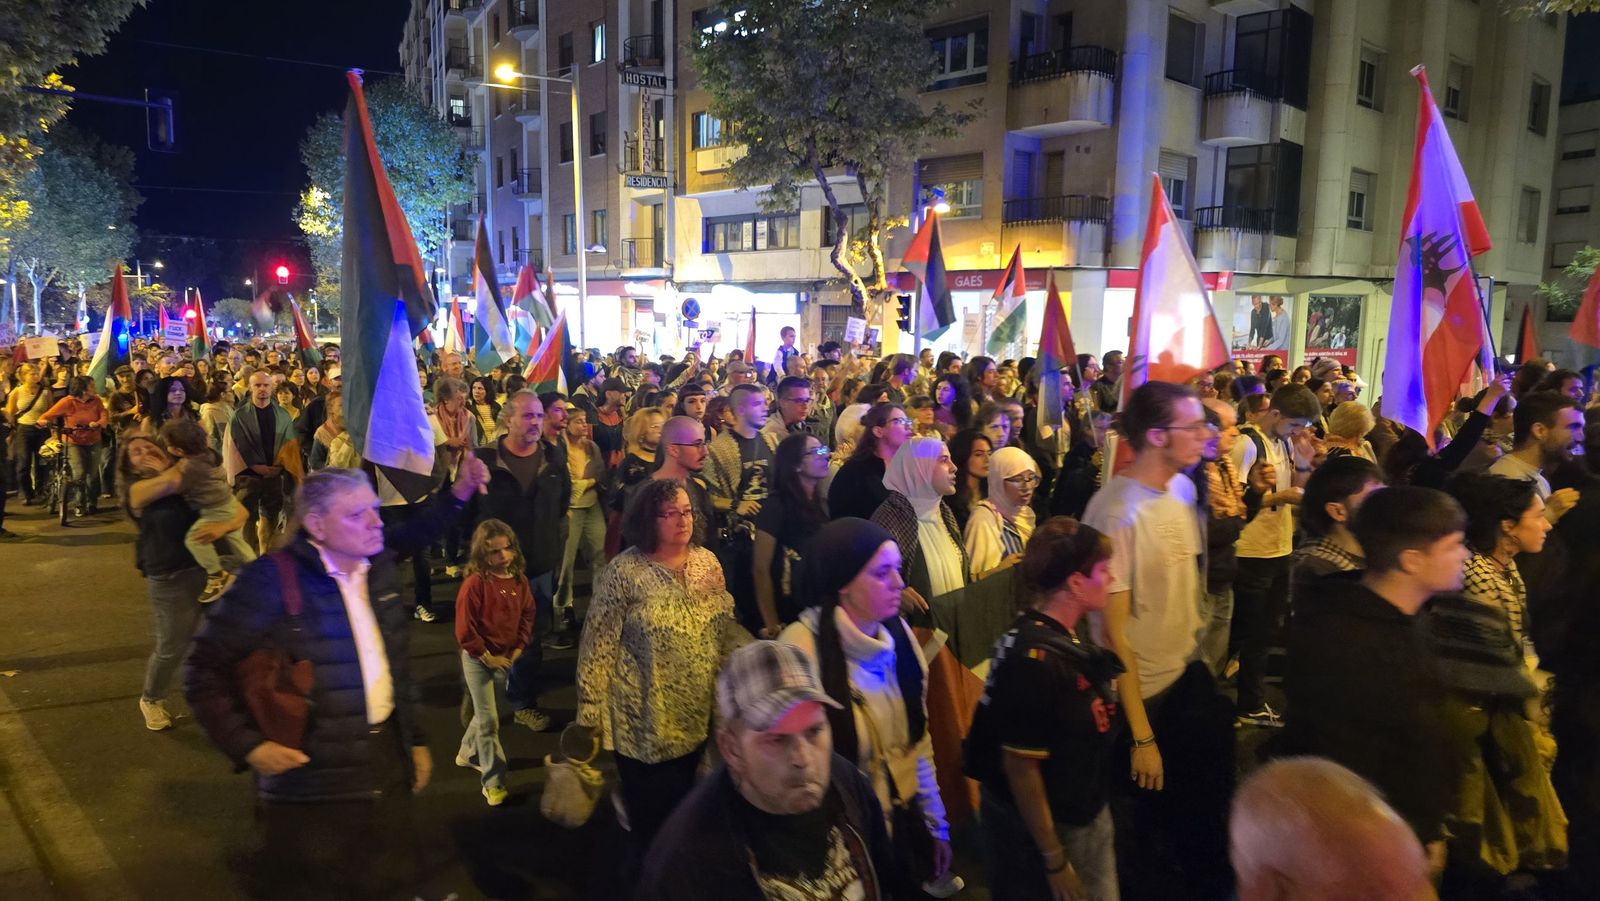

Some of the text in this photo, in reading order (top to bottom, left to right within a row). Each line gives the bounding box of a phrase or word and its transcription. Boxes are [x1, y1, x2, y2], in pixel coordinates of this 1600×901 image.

[626, 73, 664, 87] HOSTAL
[627, 175, 667, 187] RESIDENCIA
[955, 275, 983, 287] GAES
